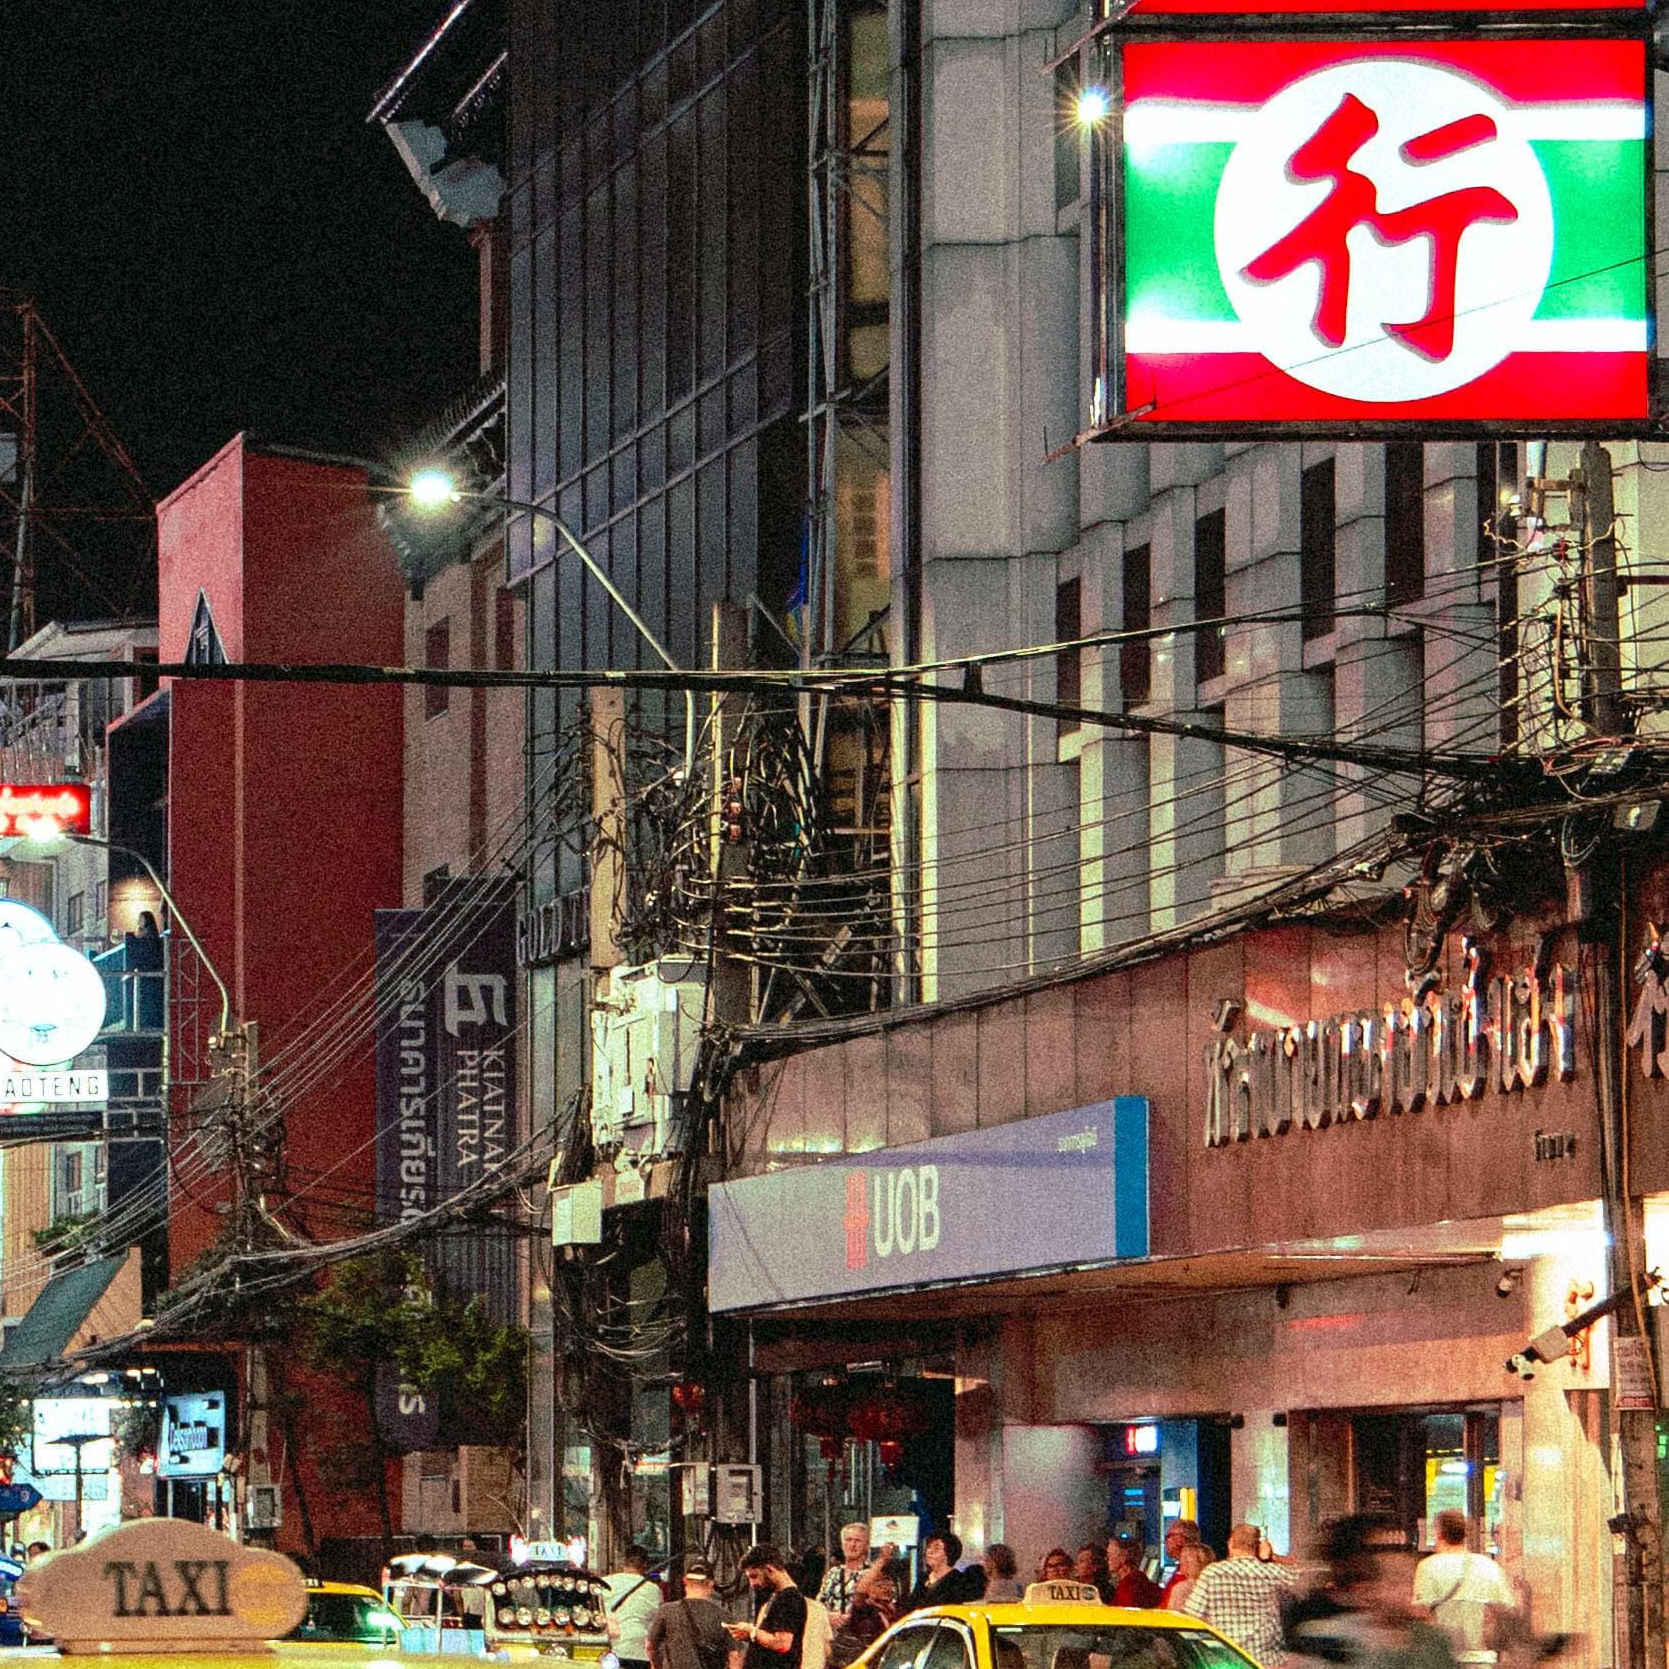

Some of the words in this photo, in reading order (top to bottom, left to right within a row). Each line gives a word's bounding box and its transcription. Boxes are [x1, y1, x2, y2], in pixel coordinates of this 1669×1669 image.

[516, 899, 563, 967] GOLD
[455, 1048, 479, 1167] PHATRA
[874, 1163, 941, 1258] UOB
[104, 1560, 234, 1617] TAXI
[1047, 1585, 1081, 1601] TAXI
